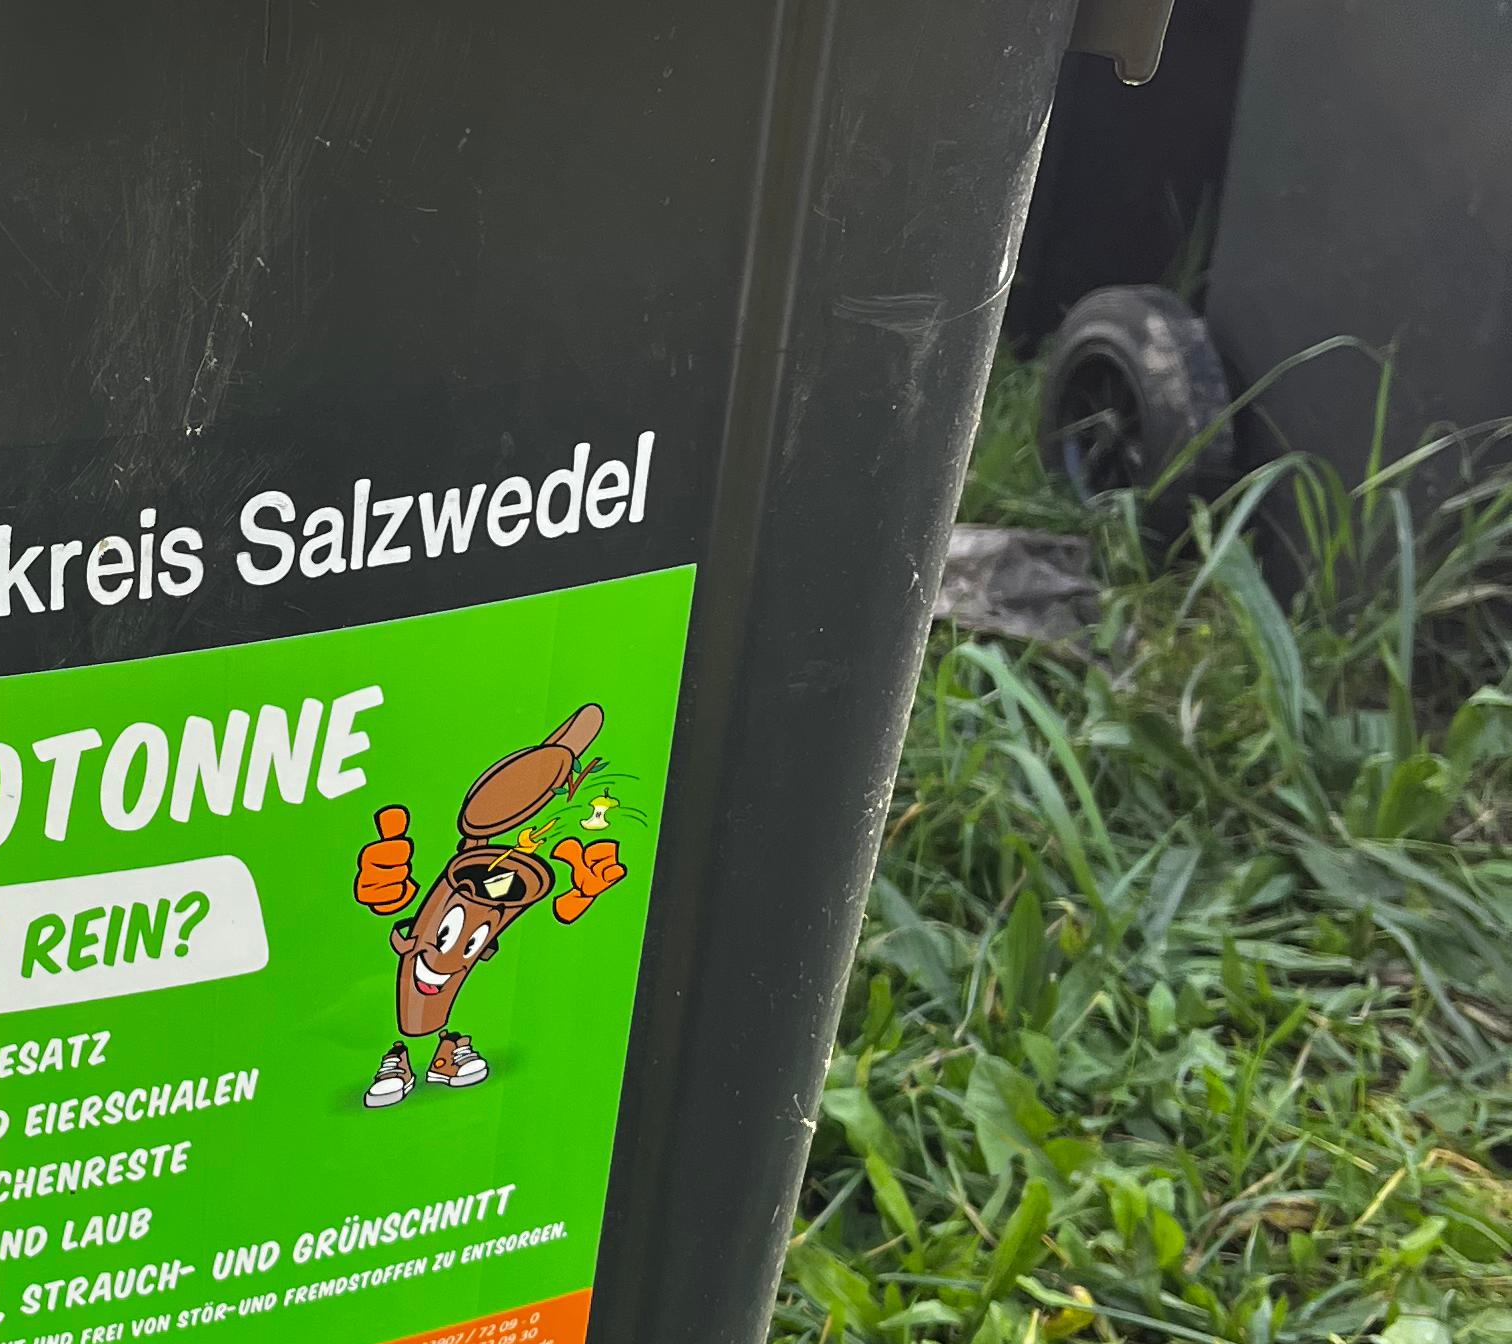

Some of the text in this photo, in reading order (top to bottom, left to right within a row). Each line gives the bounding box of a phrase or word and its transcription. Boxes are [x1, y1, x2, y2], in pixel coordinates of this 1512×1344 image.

[237, 431, 655, 585] Salzwedel
[22, 891, 210, 979] REIN?
[25, 1069, 258, 1136] EIERSCHALEN
[21, 1259, 195, 1315] STRAUCH-
[213, 1241, 280, 1280] UND
[292, 1184, 516, 1264] GRÜNSCHNITT
[62, 1208, 152, 1251] LAUB
[132, 1315, 170, 1336] VON
[284, 1258, 427, 1306] FREMDSTOFFEN
[432, 1251, 456, 1271] ZU
[461, 1222, 567, 1264] ENTSORGEN.
[478, 1324, 496, 1338] 72
[498, 1318, 518, 1333] 09
[529, 1311, 540, 1325] 0
[520, 1327, 539, 1342] 30
